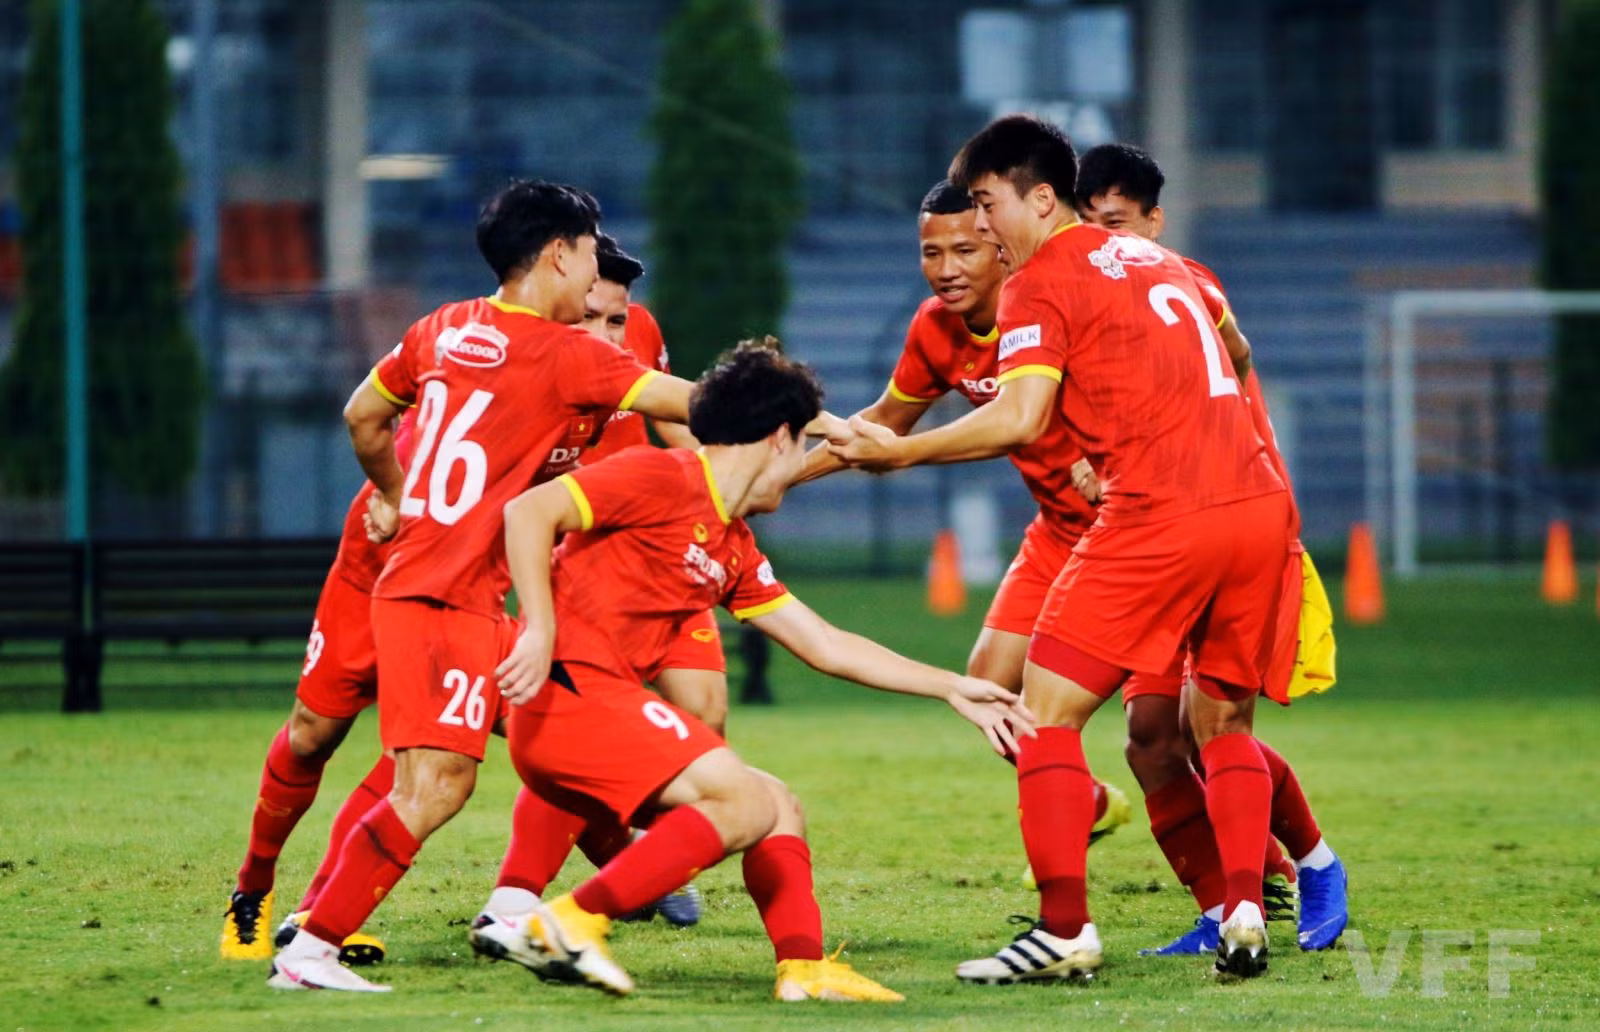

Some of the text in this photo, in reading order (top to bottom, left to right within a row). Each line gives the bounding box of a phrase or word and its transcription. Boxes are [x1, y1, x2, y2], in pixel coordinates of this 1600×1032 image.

[1148, 283, 1240, 398] 2
[400, 379, 496, 526] 26
[438, 668, 487, 731] 26
[641, 700, 690, 741] 9
